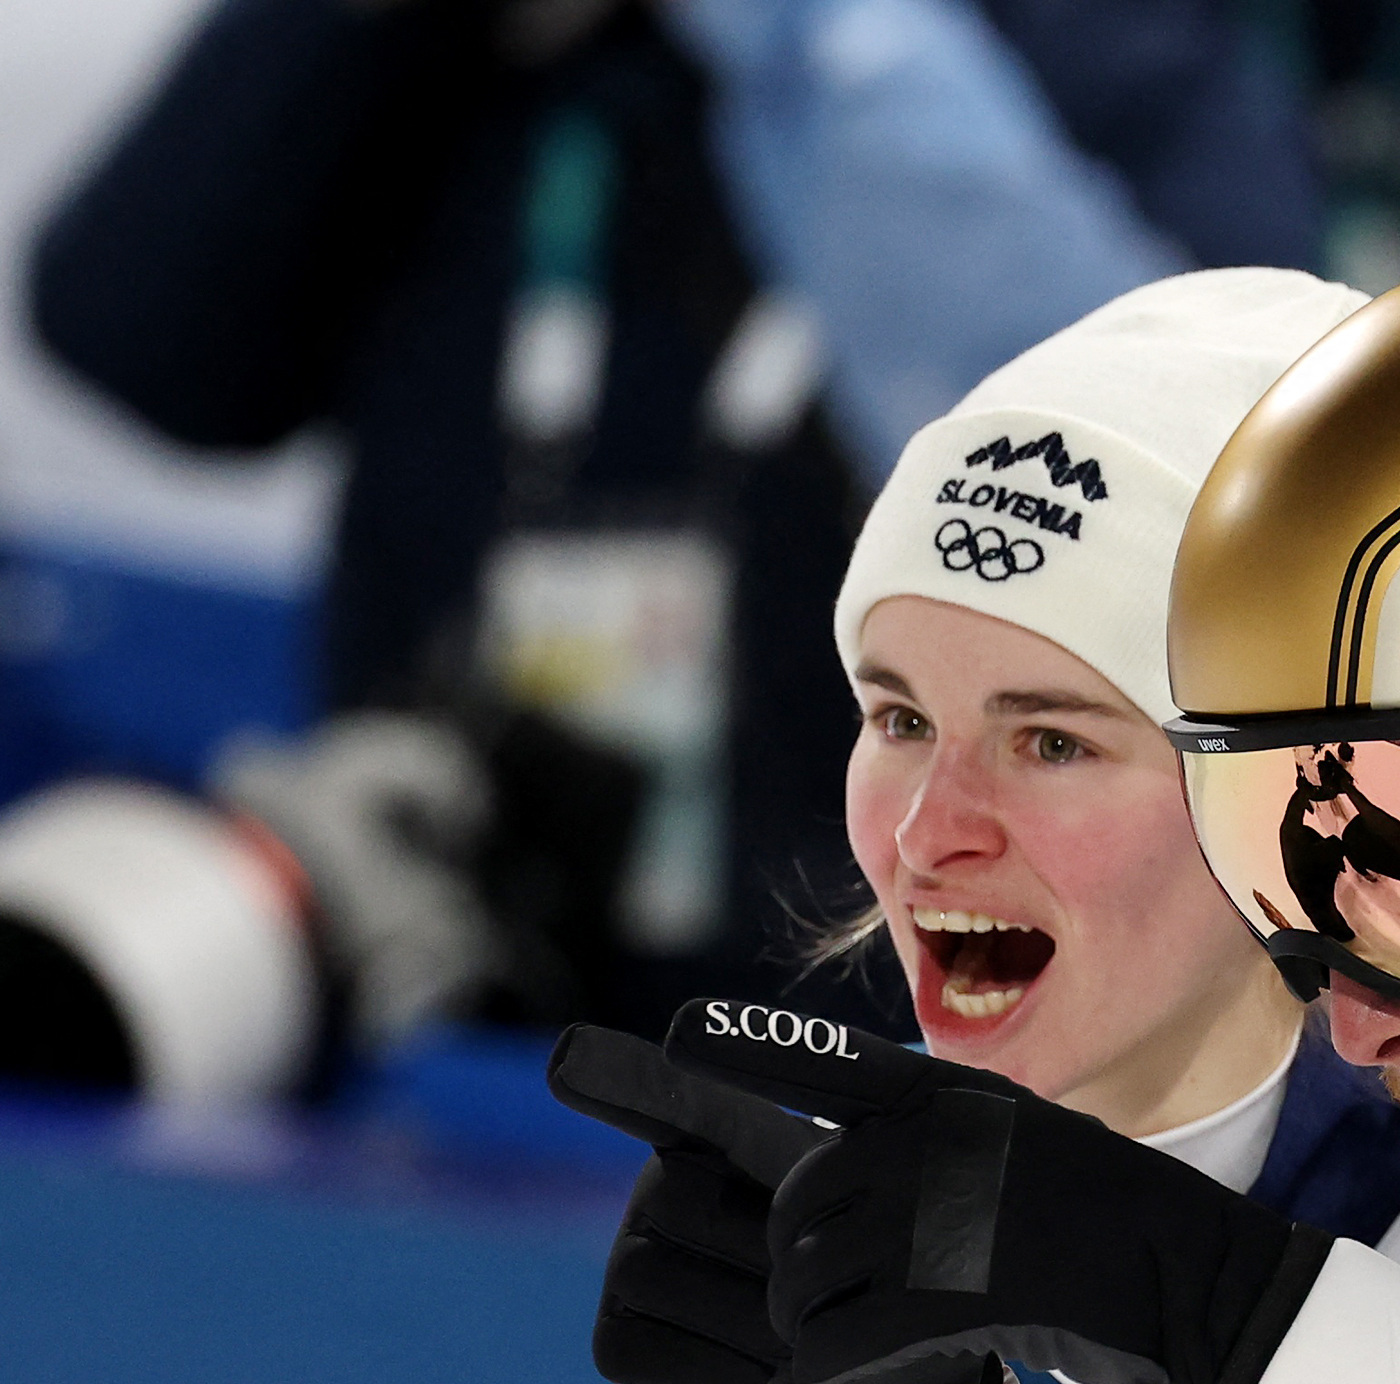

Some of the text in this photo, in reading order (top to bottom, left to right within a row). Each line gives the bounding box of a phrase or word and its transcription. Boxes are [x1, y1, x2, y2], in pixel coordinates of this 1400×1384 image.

[936, 479, 1082, 541] SLOVENIA
[1197, 738, 1230, 752] uvex
[705, 1001, 861, 1061] S.COOL
